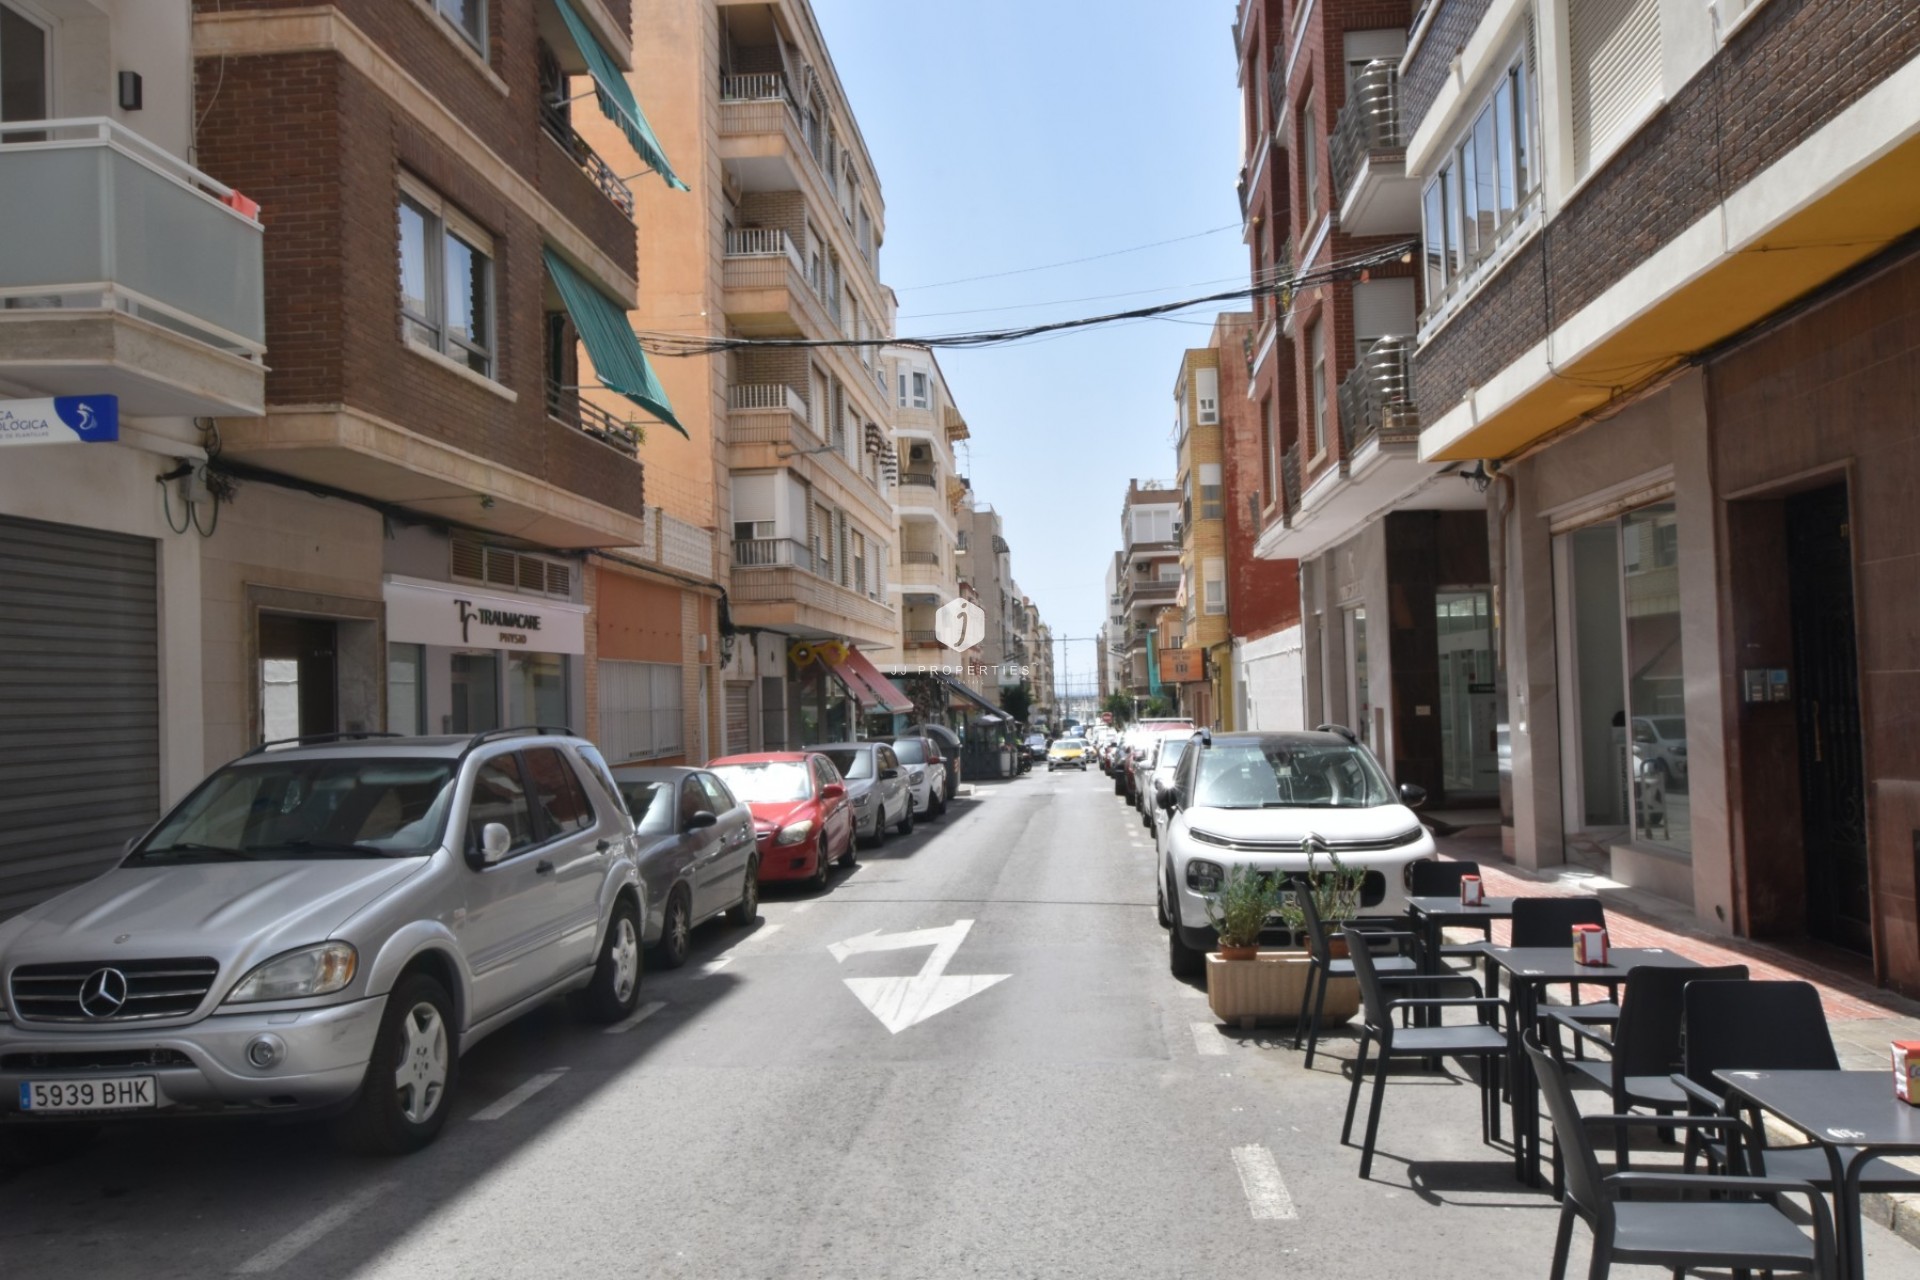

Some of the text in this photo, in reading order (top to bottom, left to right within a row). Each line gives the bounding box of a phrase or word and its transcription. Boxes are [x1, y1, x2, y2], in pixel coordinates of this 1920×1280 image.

[0, 419, 49, 431] LÓGICA
[478, 608, 542, 631] TRAUMACARE
[499, 632, 528, 645] PHYSIO
[34, 1080, 148, 1107] 5939 BHK
